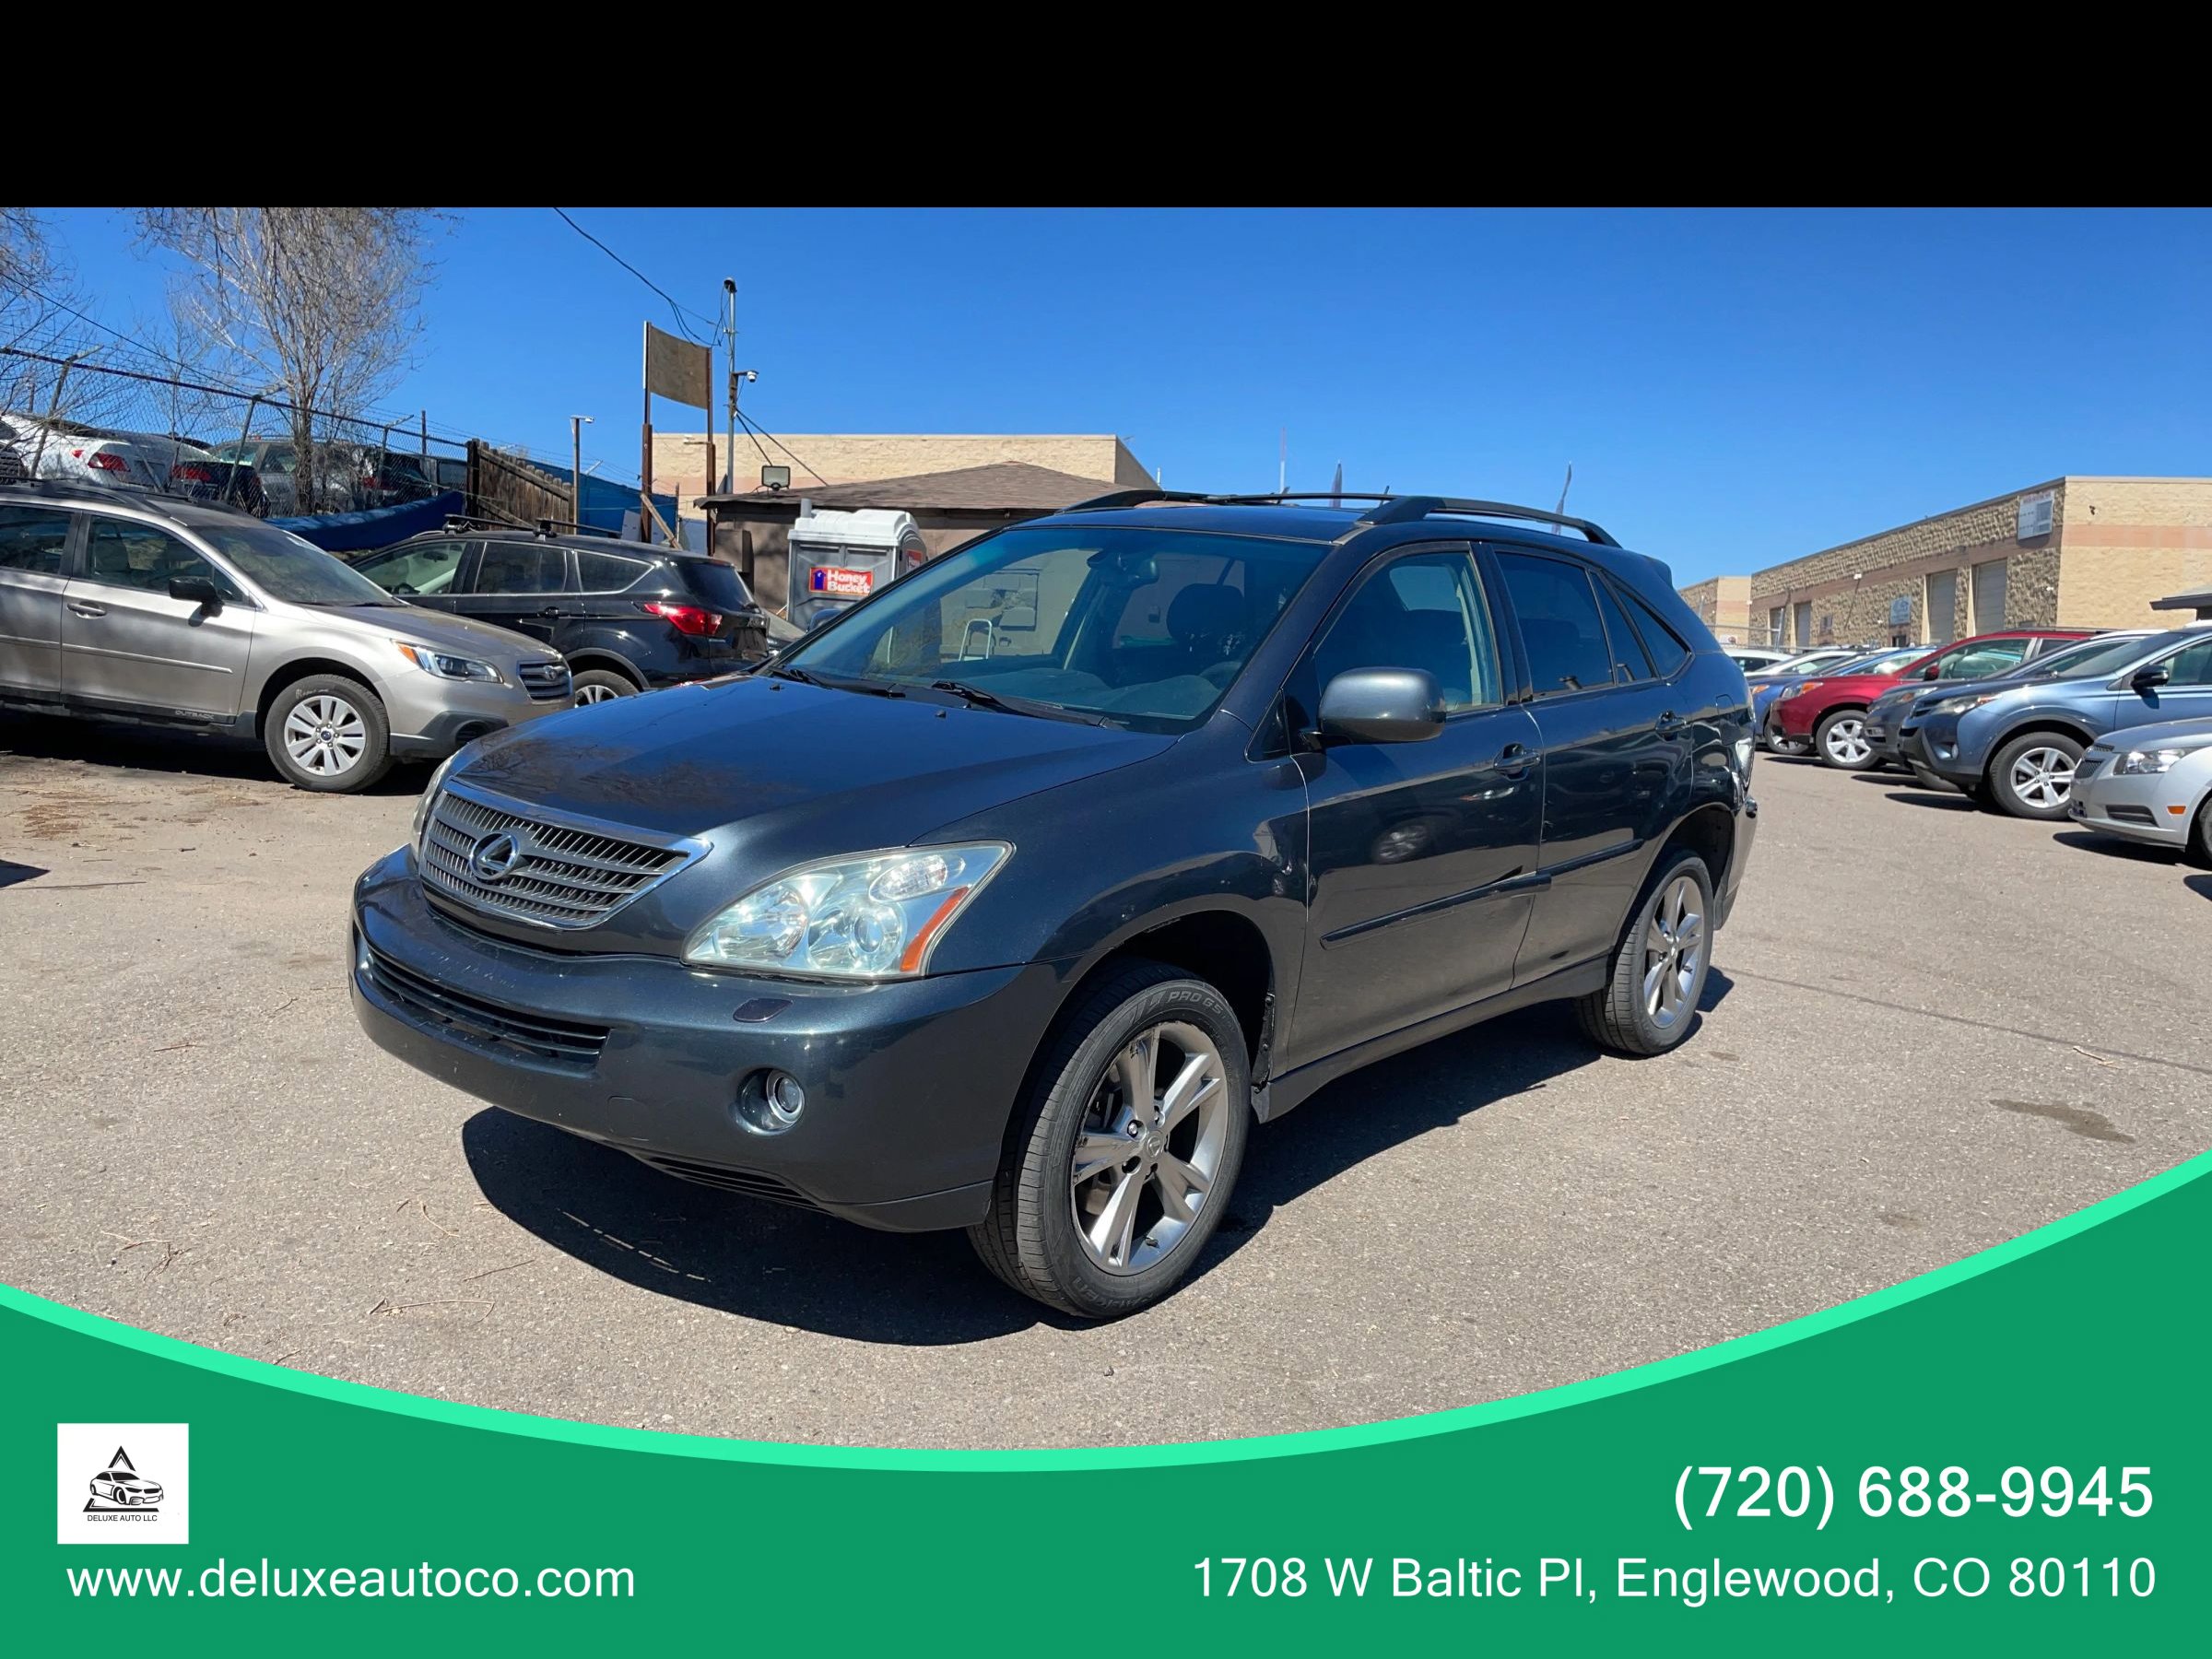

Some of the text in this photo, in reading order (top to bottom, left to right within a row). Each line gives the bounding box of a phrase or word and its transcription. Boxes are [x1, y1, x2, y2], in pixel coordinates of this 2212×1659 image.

[827, 569, 867, 585] Honey
[827, 581, 871, 594] Bucket
[1167, 991, 1203, 1004] PRO
